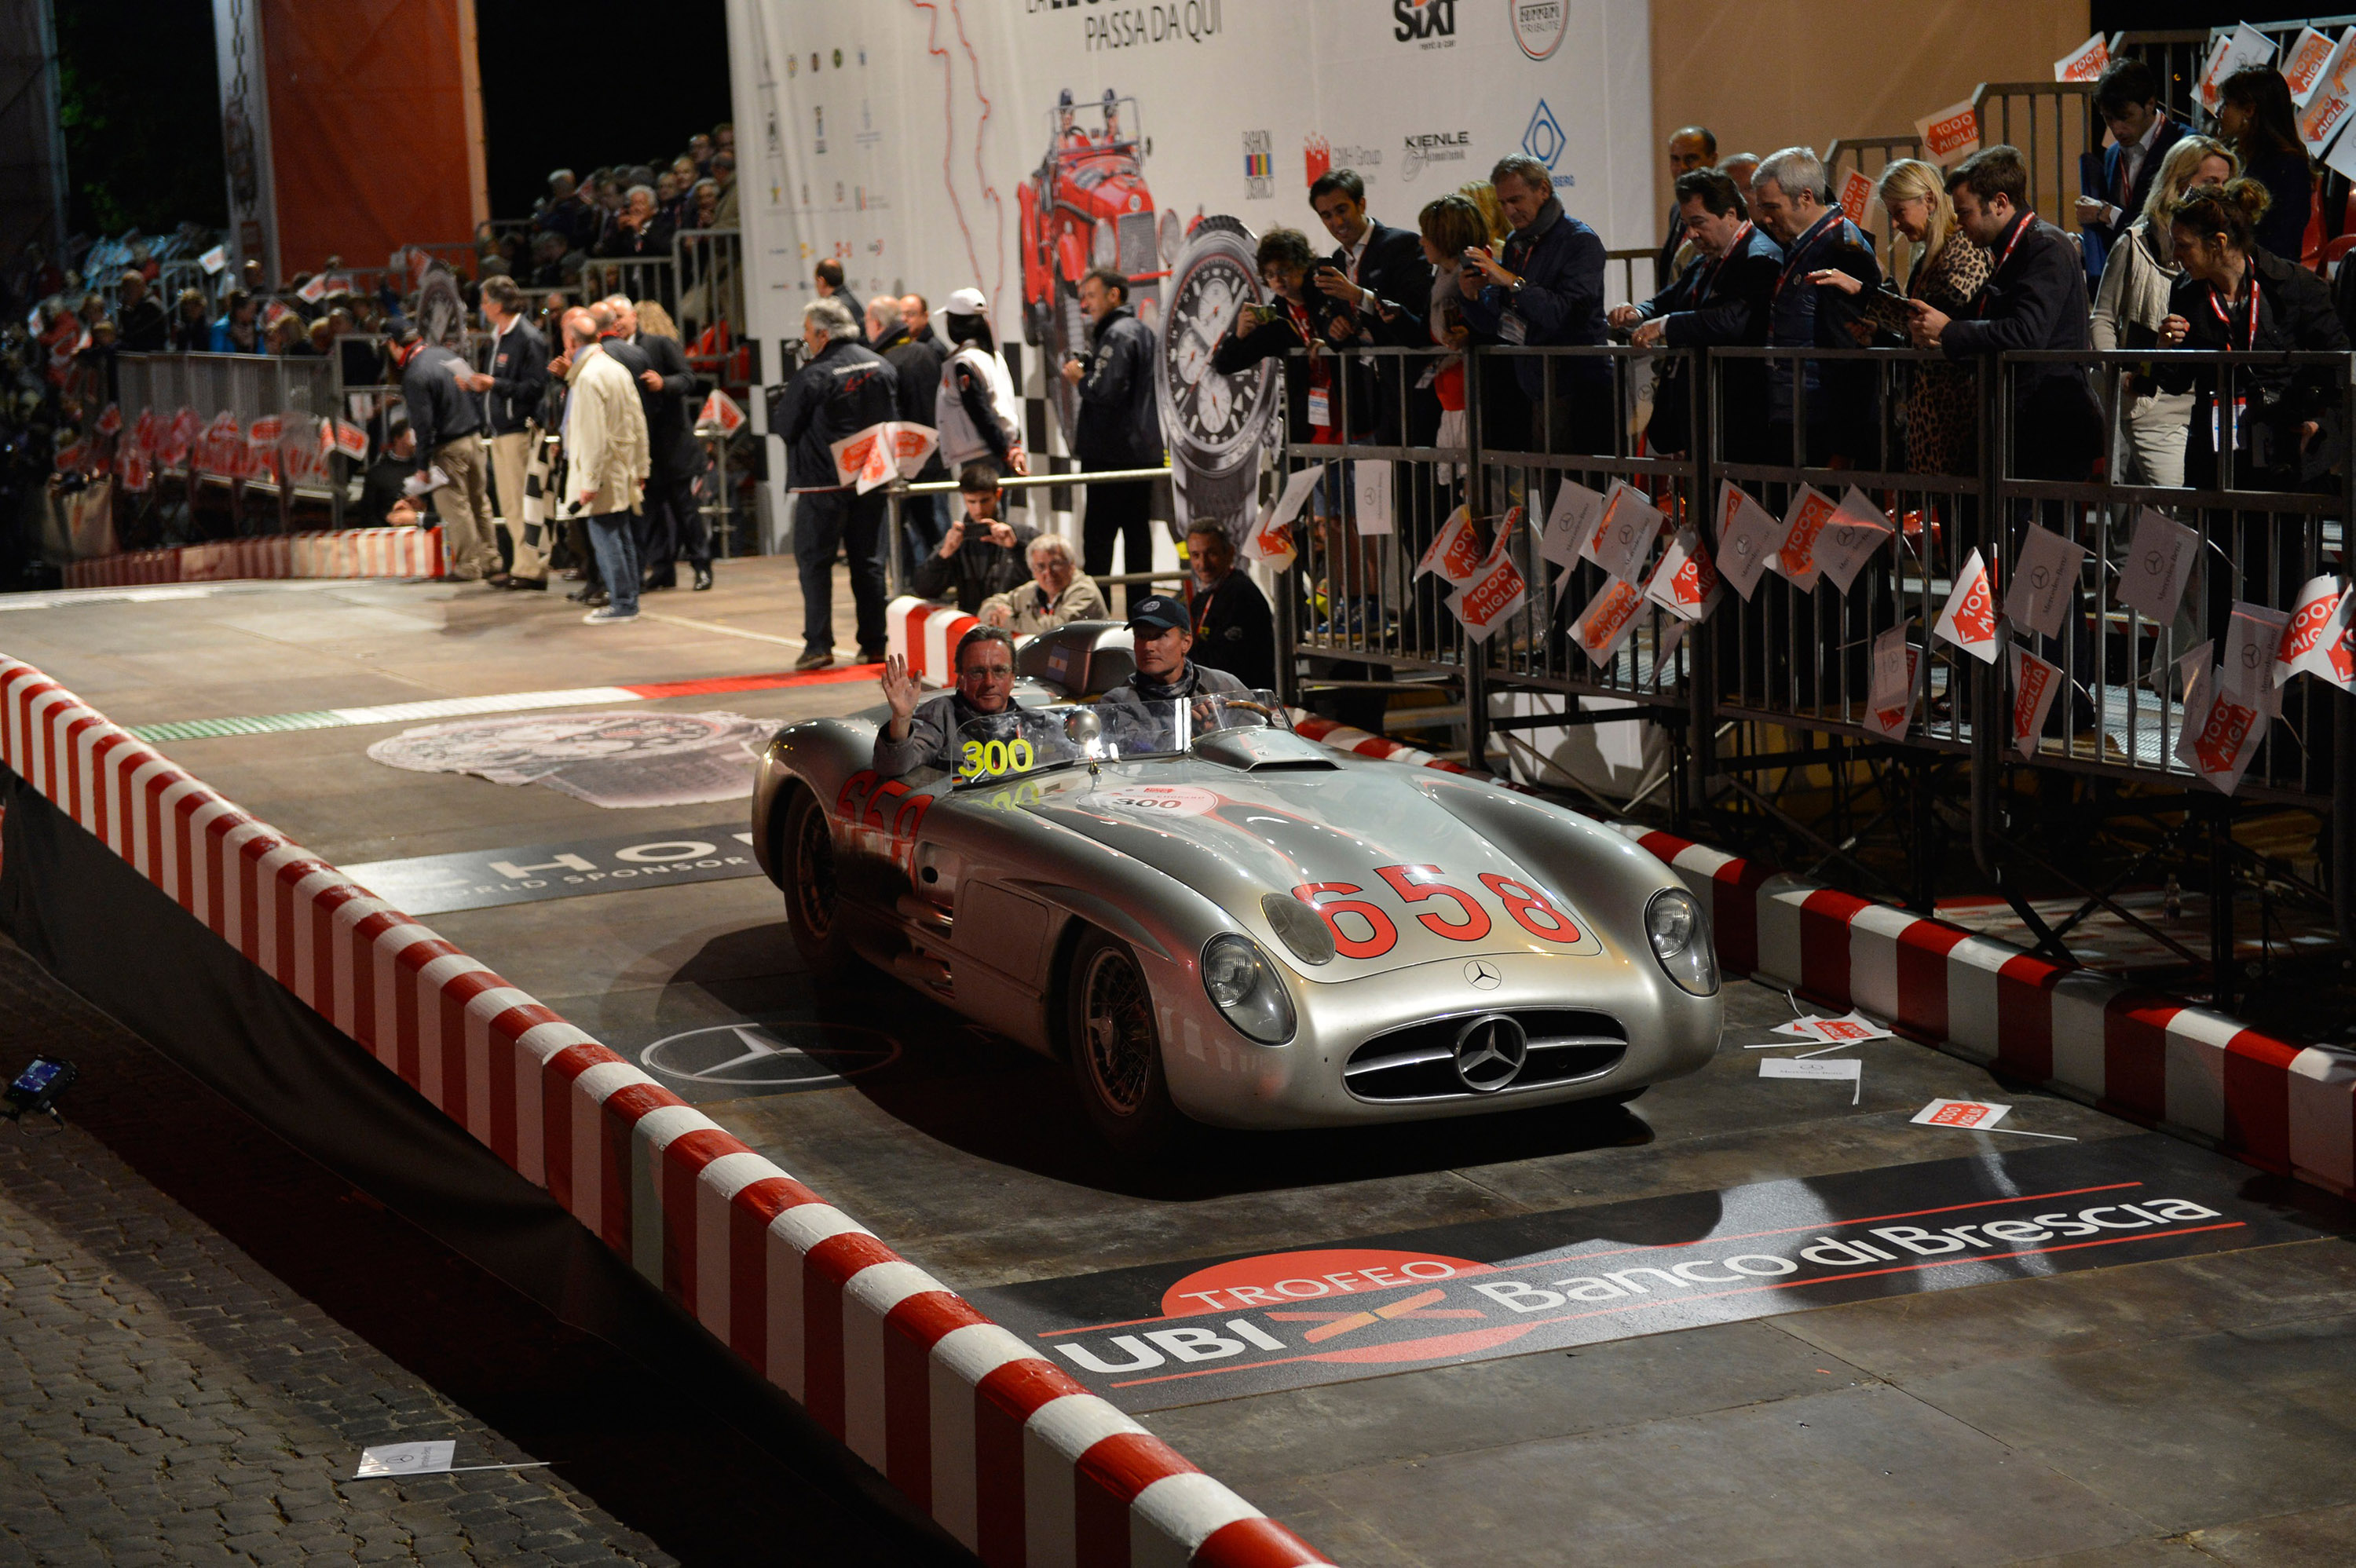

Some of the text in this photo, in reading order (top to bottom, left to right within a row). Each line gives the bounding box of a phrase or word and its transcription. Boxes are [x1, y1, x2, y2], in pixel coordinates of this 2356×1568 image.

[1085, 0, 1222, 52] PASSA DA QUI
[2074, 47, 2104, 74] 1000
[2292, 39, 2317, 77] 1000
[2301, 42, 2332, 88] MIGLIA
[1936, 114, 1973, 136] 1000
[2311, 97, 2333, 123] 100
[1405, 131, 1469, 148] KIENLE
[1939, 125, 1979, 150] MIGLIA
[1843, 180, 1858, 212] 000
[1451, 528, 1473, 558] 100
[1788, 503, 1817, 552] 1000
[1681, 550, 1707, 581] 100
[1471, 568, 1509, 603] 1000
[1479, 578, 1523, 620] MIGLIA
[2043, 556, 2069, 614] Mercedes-Benz
[1592, 586, 1626, 627] 1000
[1600, 594, 1641, 641] MIGLIA
[2017, 661, 2032, 711] 1000
[2021, 667, 2046, 729] MIGLIA
[957, 738, 1034, 777] 300
[1112, 797, 1182, 809] 300
[563, 856, 749, 884] SPONSOR
[1290, 864, 1582, 959] 658
[1937, 1106, 1963, 1123] 1000
[1055, 1198, 2222, 1374] UBI Banco di Brescia
[1179, 1260, 1457, 1310] TROFEO
